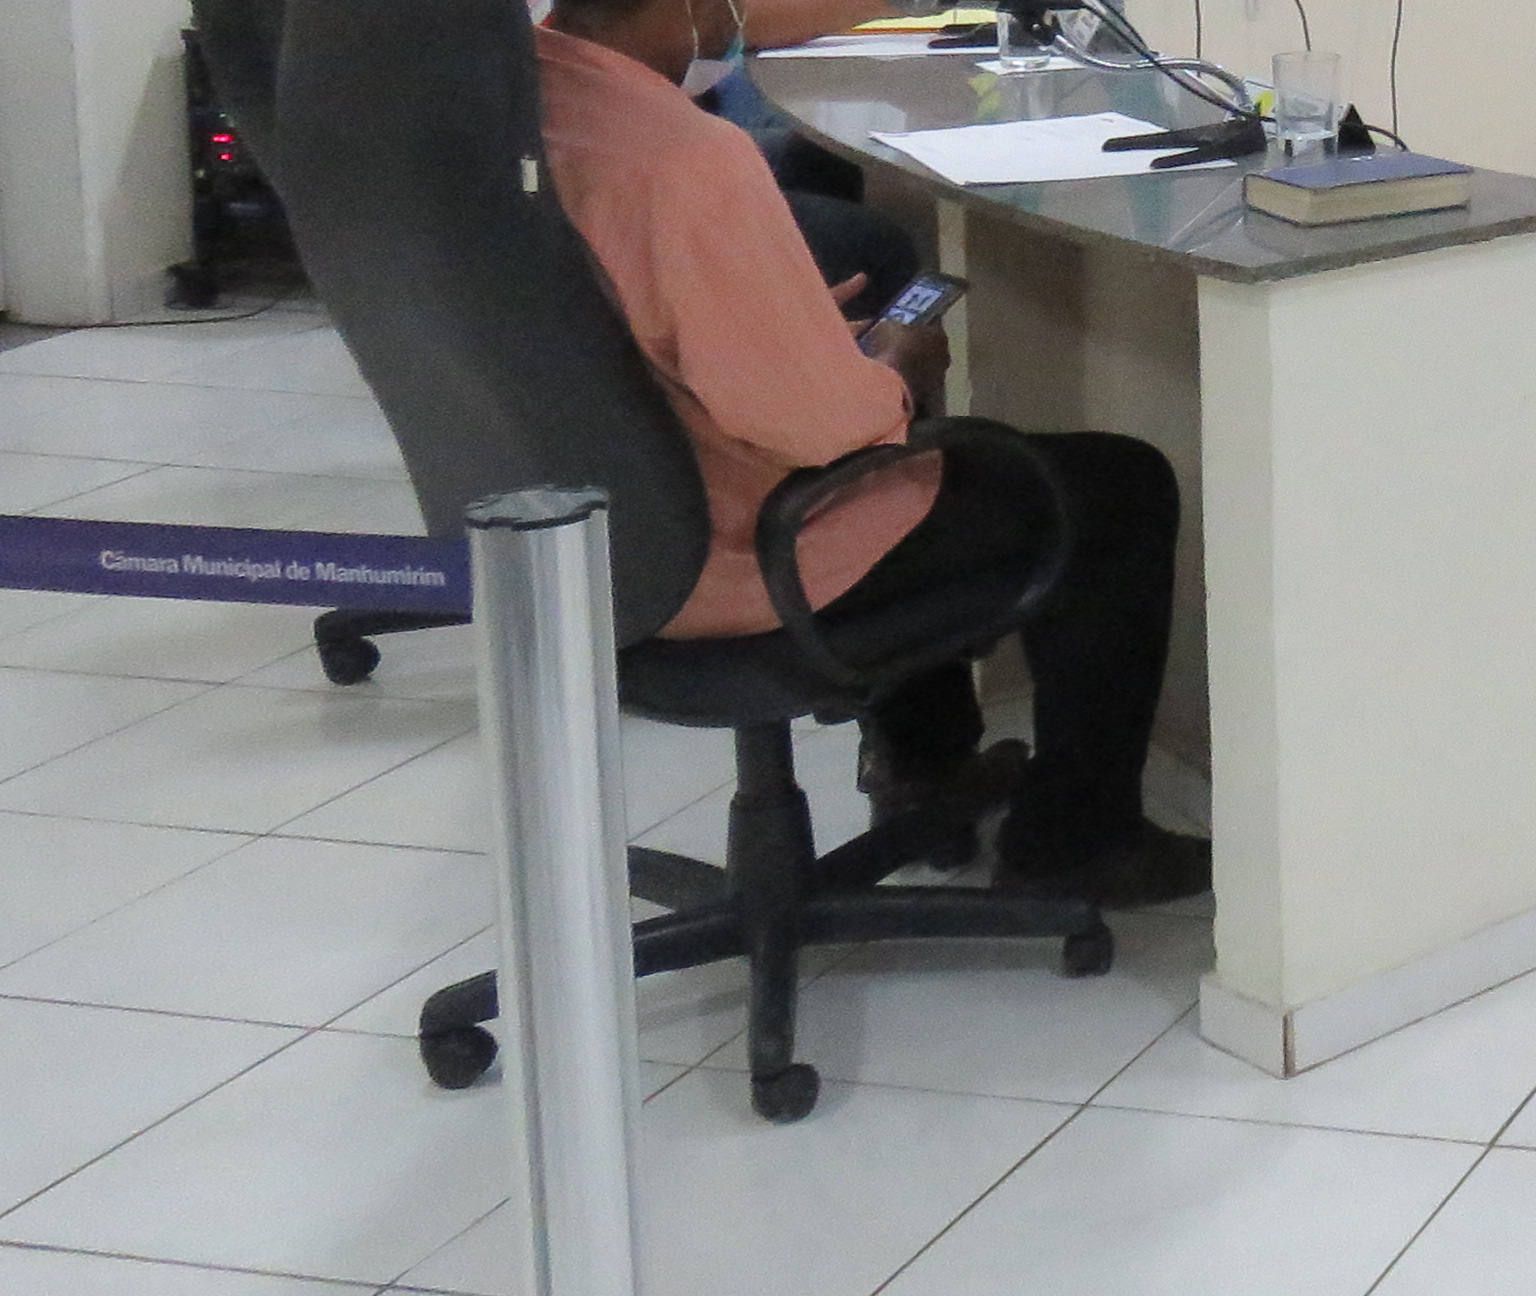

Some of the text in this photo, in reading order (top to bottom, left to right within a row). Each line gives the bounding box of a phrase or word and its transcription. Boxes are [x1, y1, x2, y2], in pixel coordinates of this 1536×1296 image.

[101, 549, 446, 586] Câmara Municipal de Manhumirim
